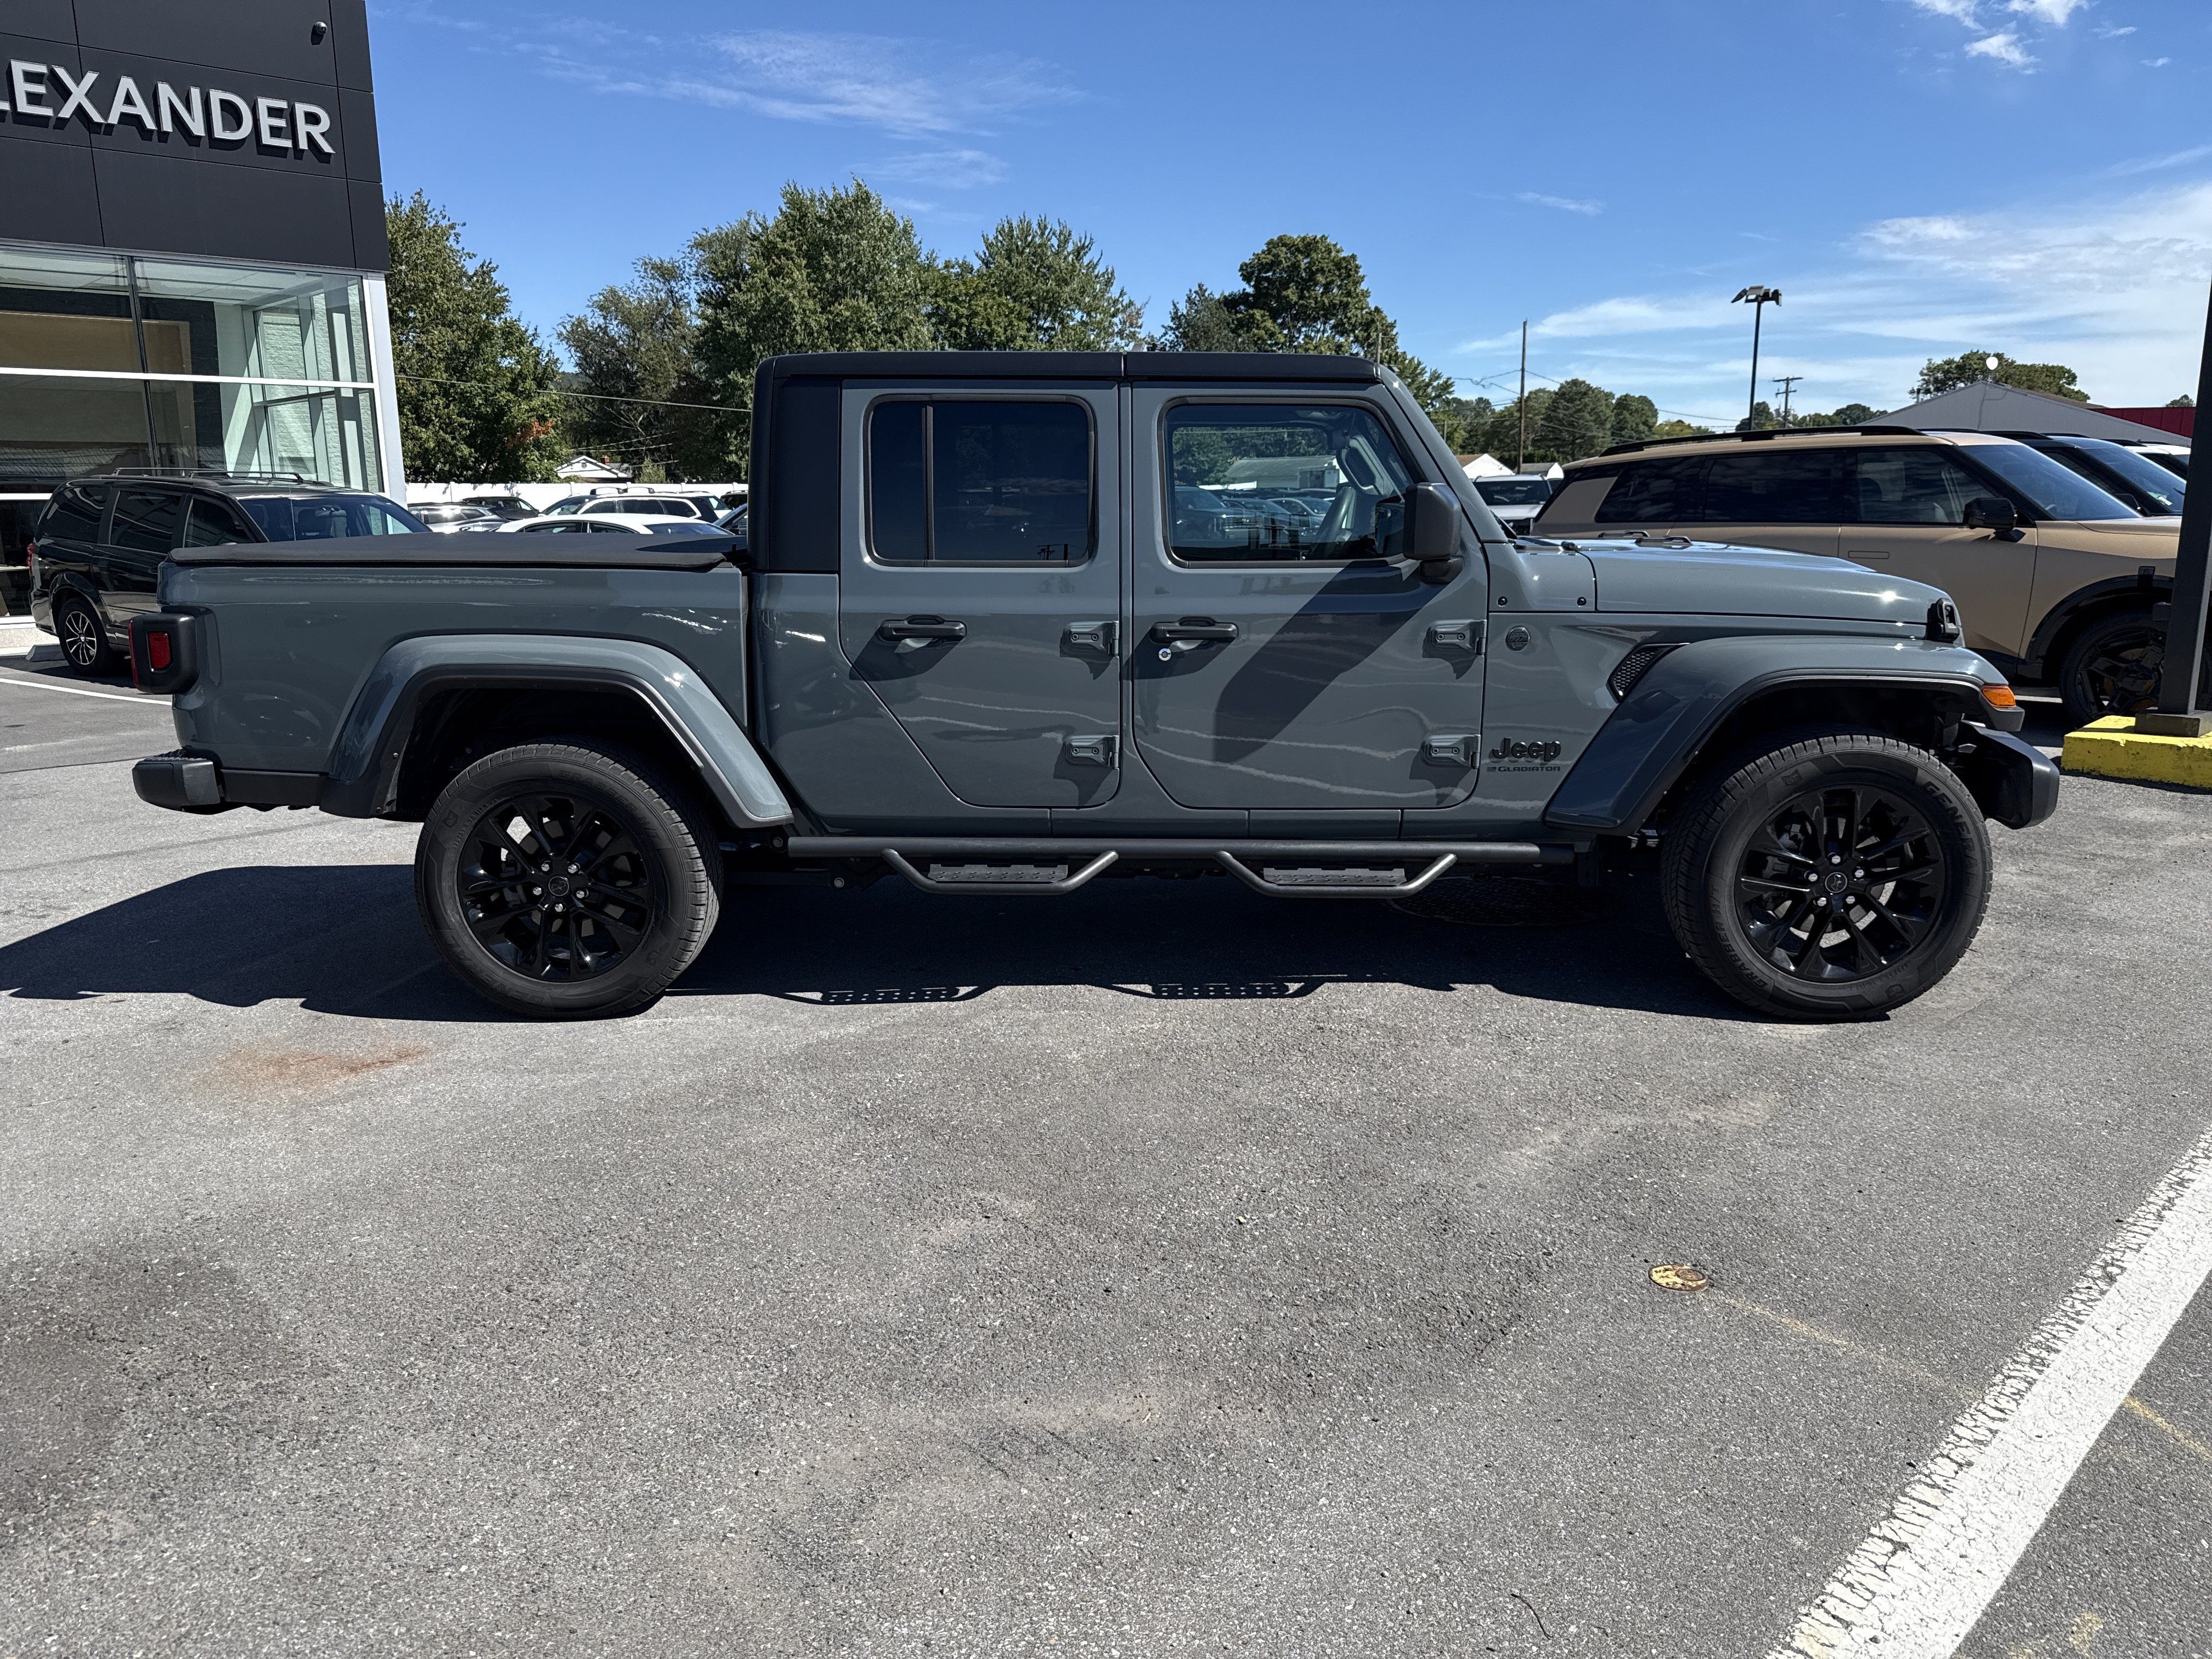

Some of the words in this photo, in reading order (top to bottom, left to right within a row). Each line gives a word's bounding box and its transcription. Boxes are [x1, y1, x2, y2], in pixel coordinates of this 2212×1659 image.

[0, 59, 335, 153] EXANDER
[1492, 737, 1561, 761] Jeep
[1922, 781, 1978, 884] GENERAL
[1714, 922, 1768, 988] GRABBER
